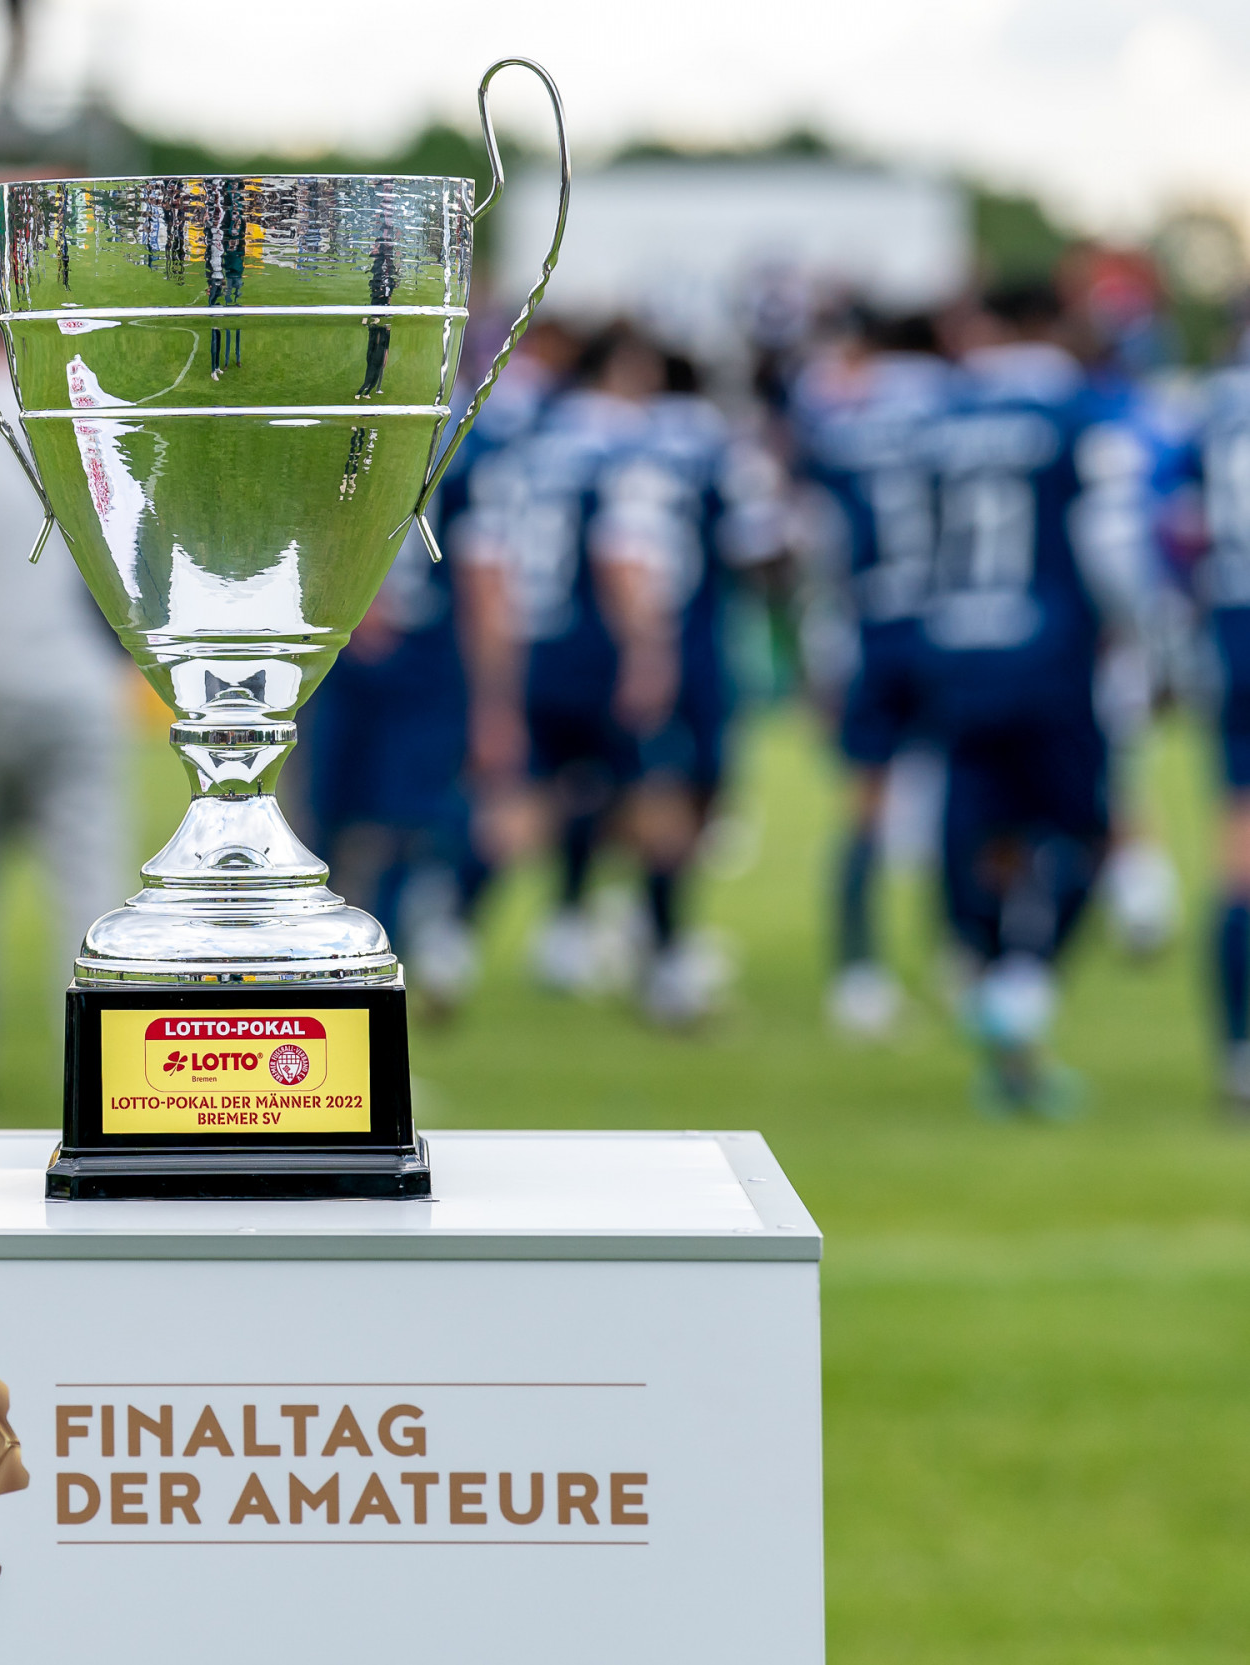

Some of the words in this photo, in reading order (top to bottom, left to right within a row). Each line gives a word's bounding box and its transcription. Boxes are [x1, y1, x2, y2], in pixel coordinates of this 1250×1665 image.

[164, 1021, 306, 1036] LOTTO-POKAL
[191, 1075, 218, 1083] Bremen
[111, 1096, 218, 1110] LOTTO-POKAL
[221, 1096, 251, 1109] DER
[255, 1093, 322, 1109] MÄNNER
[325, 1095, 363, 1109] 2022
[197, 1112, 259, 1125] BREMER
[262, 1112, 282, 1125] SV
[55, 1404, 428, 1458] FINALTAG
[56, 1472, 202, 1525] DER
[228, 1472, 650, 1526] AMATEURE
